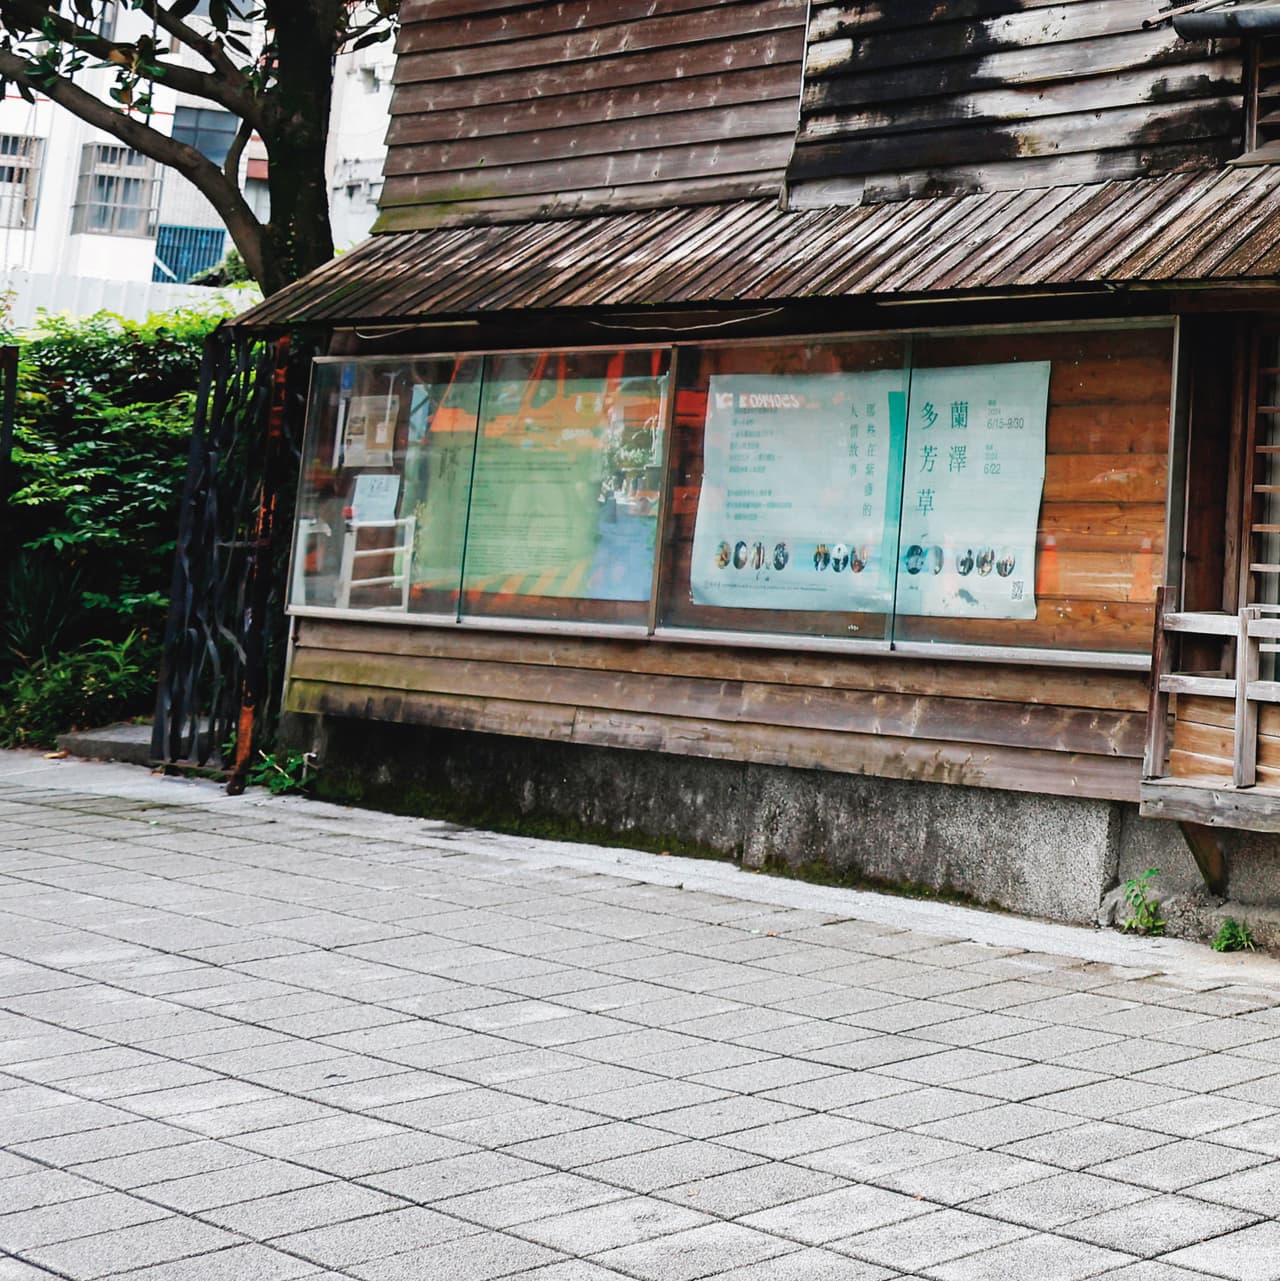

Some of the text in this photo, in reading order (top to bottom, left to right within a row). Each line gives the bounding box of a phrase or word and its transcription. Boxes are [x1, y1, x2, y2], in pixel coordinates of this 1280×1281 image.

[915, 401, 938, 517] 多芳草
[949, 400, 969, 473] 蘭澤
